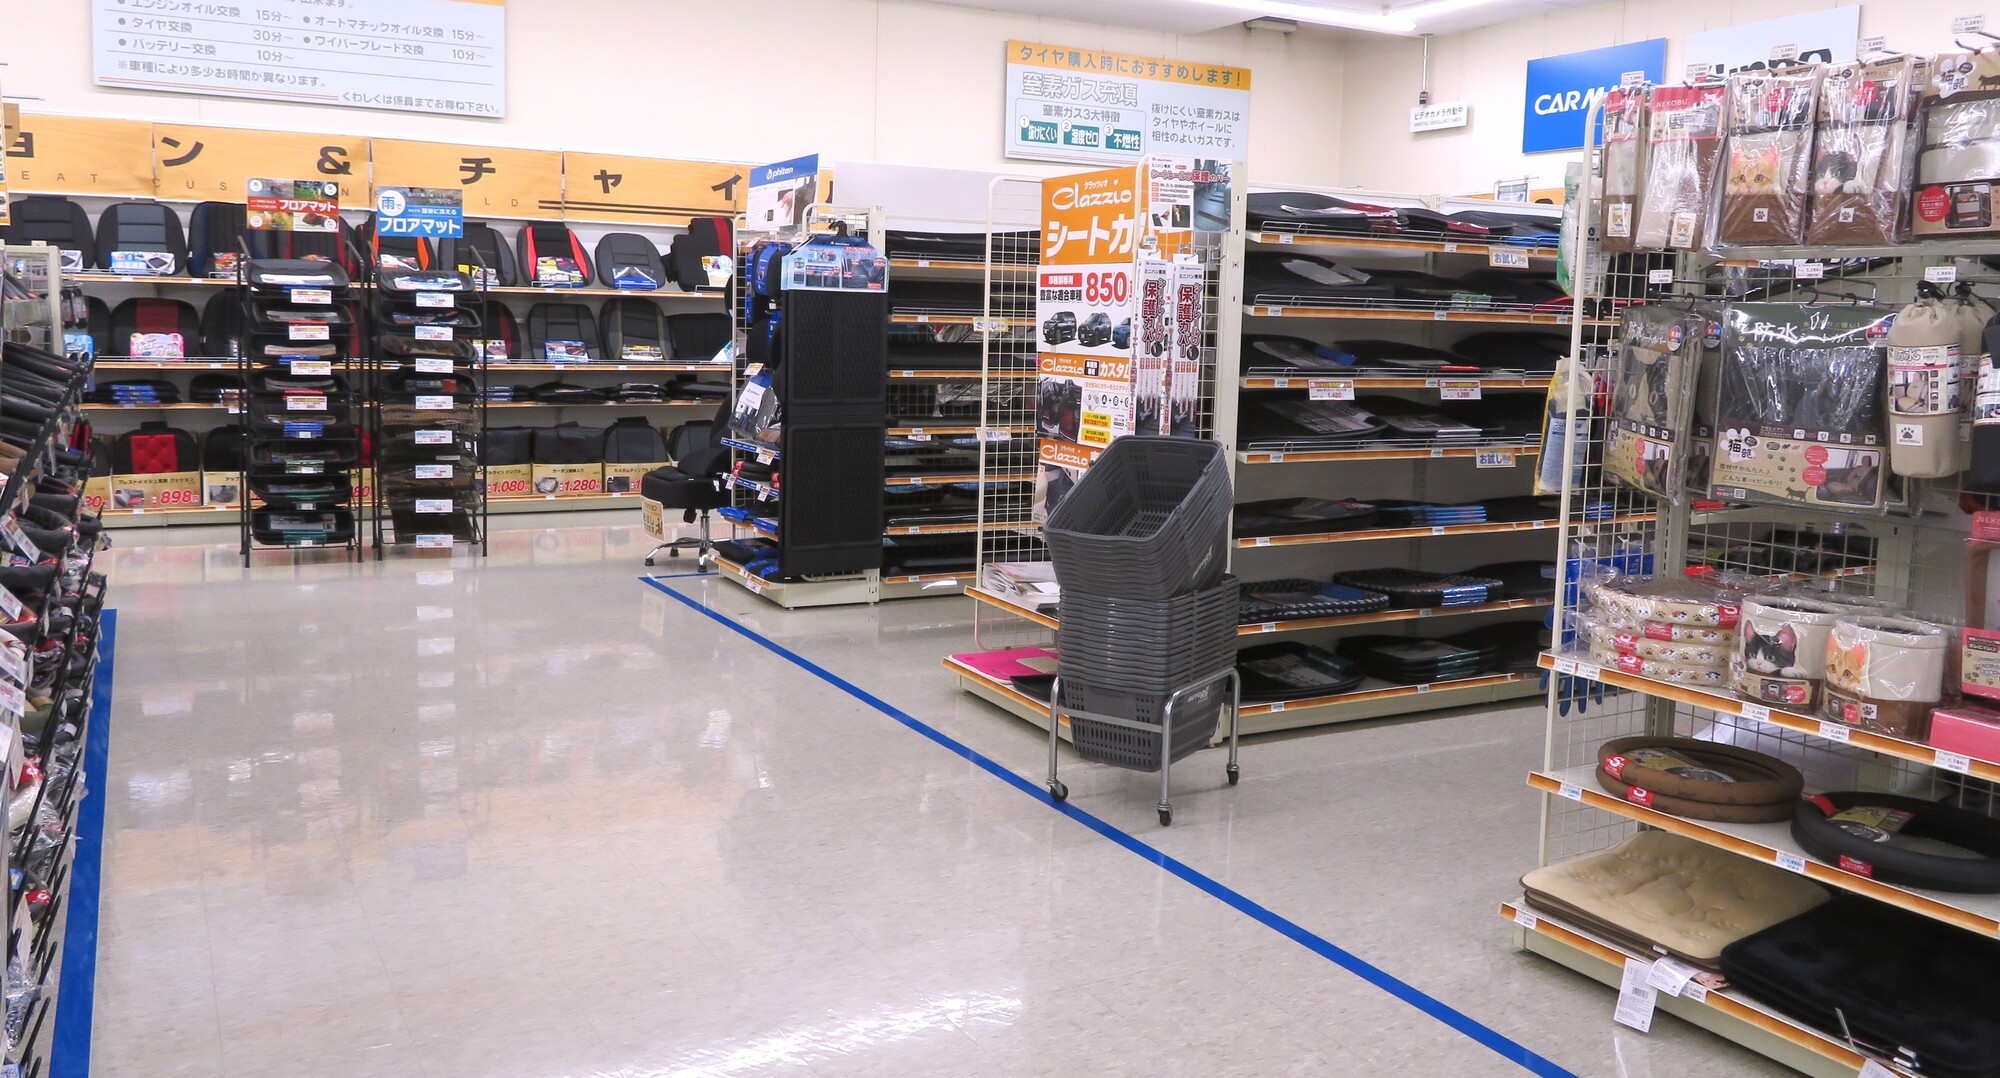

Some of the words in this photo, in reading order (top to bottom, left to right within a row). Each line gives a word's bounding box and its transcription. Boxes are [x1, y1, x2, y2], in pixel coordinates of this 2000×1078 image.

[132, 17, 193, 33] タイヤ交換
[315, 16, 444, 39] オートマチックオイル交換
[133, 38, 217, 56] バッテリー交換
[1151, 103, 1240, 122] 抜けにくい窒素ガスは
[1152, 117, 1232, 134] タイヤやホイールに
[772, 166, 794, 180] phiten
[1052, 179, 1132, 210] Clazzio
[279, 199, 337, 213] フロアマット
[378, 216, 461, 235] フロアマット
[1046, 212, 1147, 258] シートカ
[1085, 272, 1128, 303] 850
[1142, 279, 1157, 354] 保護カバー
[1177, 284, 1193, 359] 保護カバー
[1040, 358, 1084, 375] Clazzio
[1040, 444, 1088, 466] Clazzio
